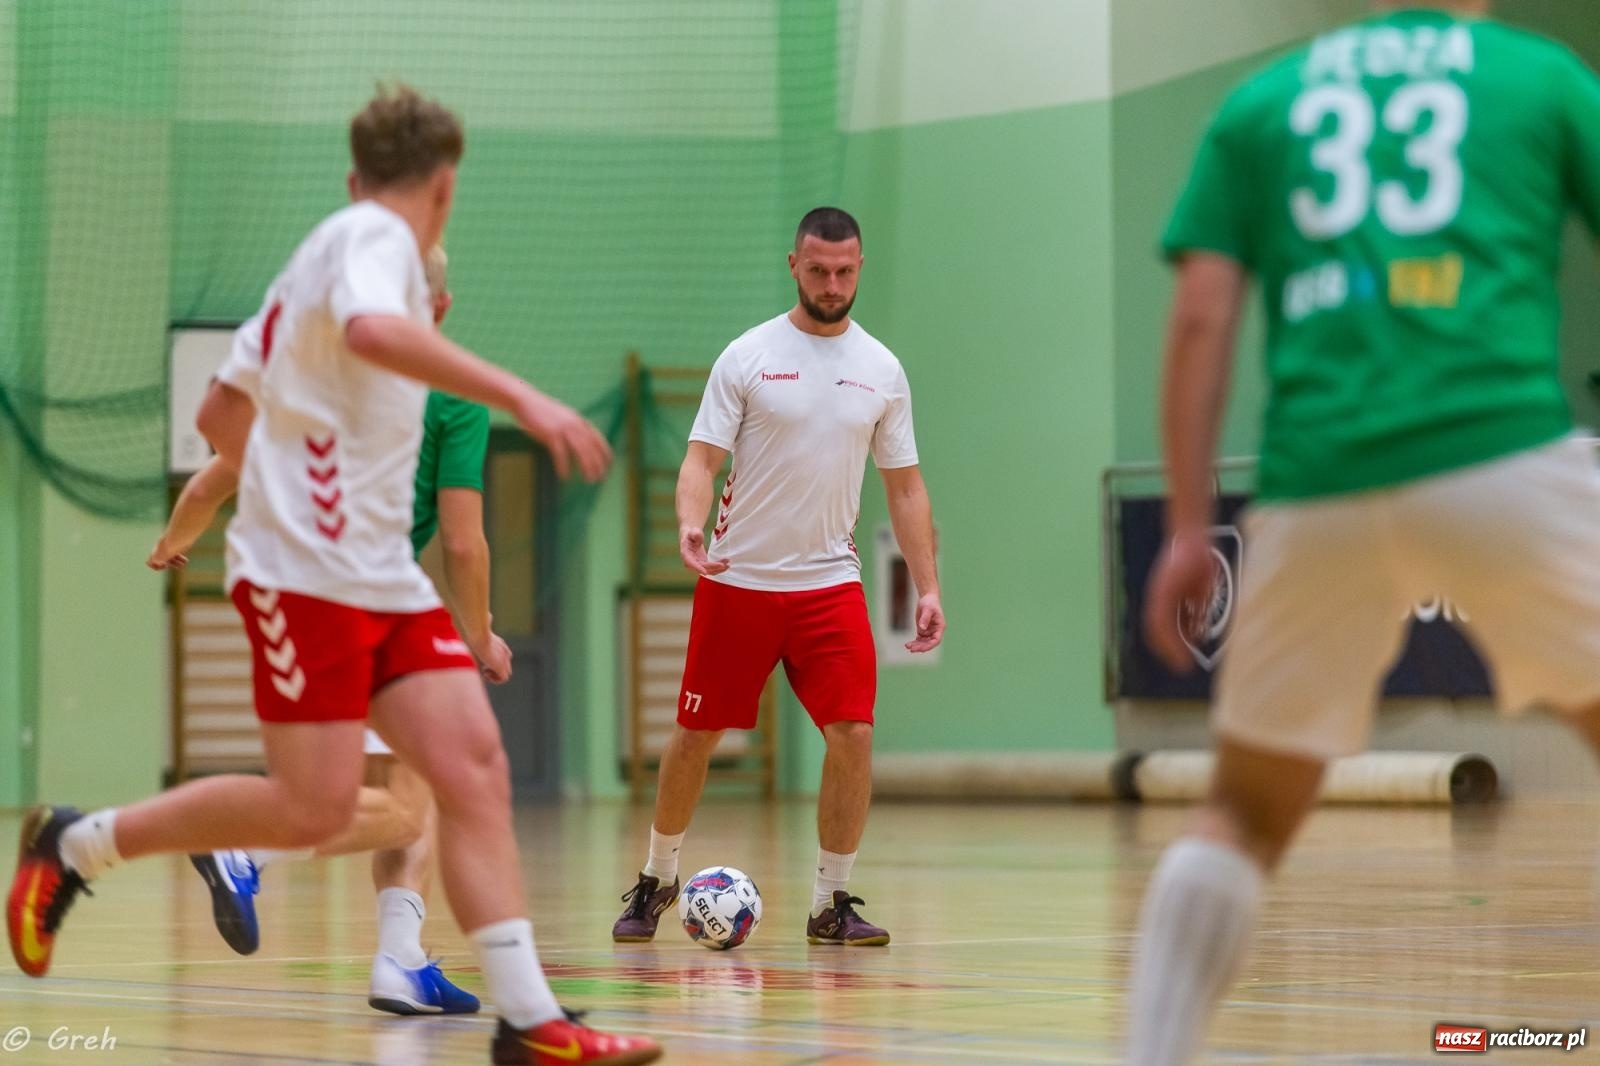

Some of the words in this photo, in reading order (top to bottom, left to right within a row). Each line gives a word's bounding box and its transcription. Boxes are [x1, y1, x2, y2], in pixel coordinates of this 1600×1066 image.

[1288, 81, 1469, 241] 33
[762, 371, 799, 381] hummel
[695, 897, 727, 936] SELECT
